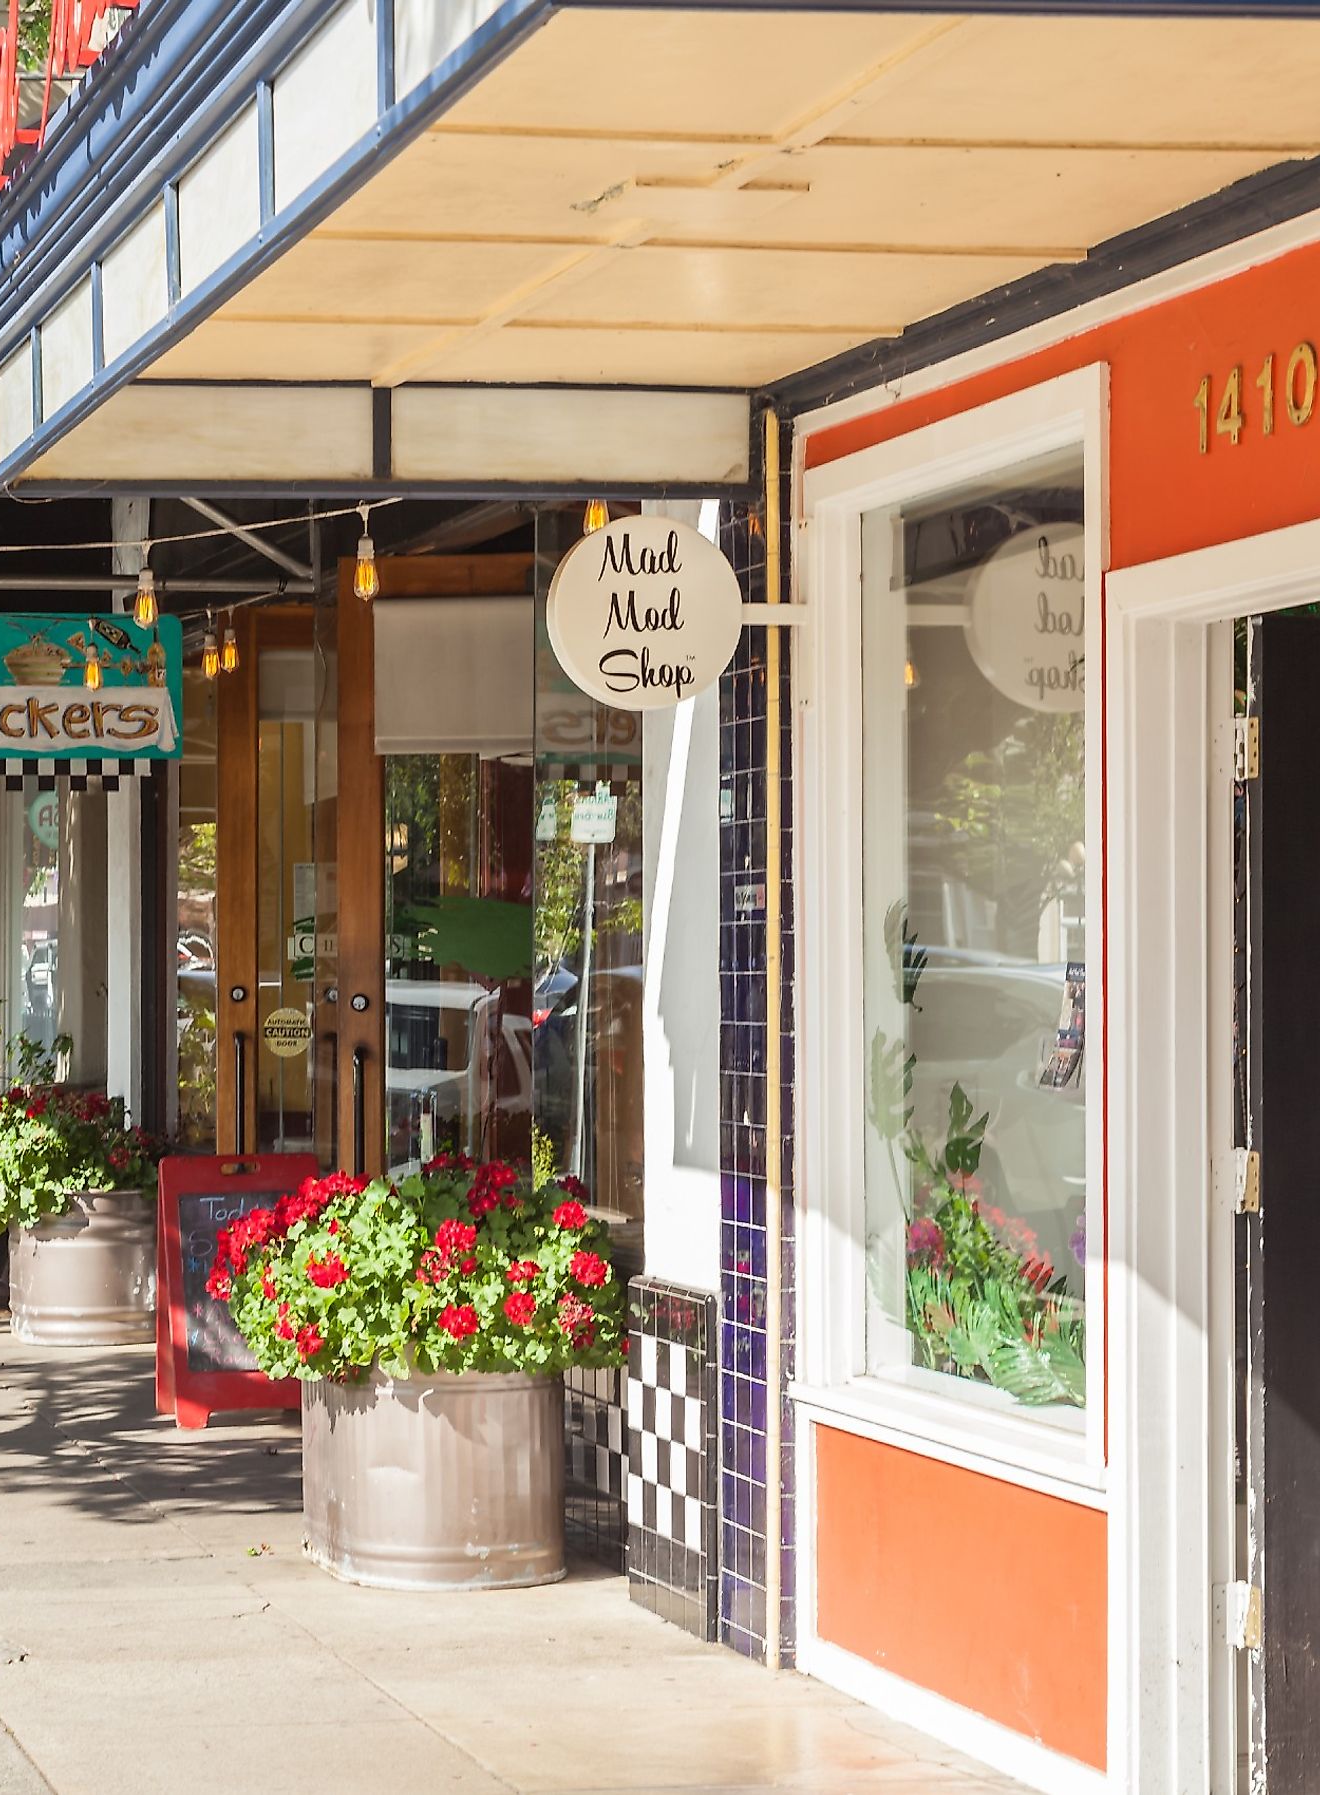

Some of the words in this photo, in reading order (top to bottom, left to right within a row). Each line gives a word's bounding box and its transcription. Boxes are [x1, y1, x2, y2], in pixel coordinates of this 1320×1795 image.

[1193, 341, 1317, 454] 1410
[598, 530, 683, 582] Mad
[603, 587, 685, 639] Mod
[598, 646, 695, 699] Shop
[266, 1028, 309, 1038] CAUTION
